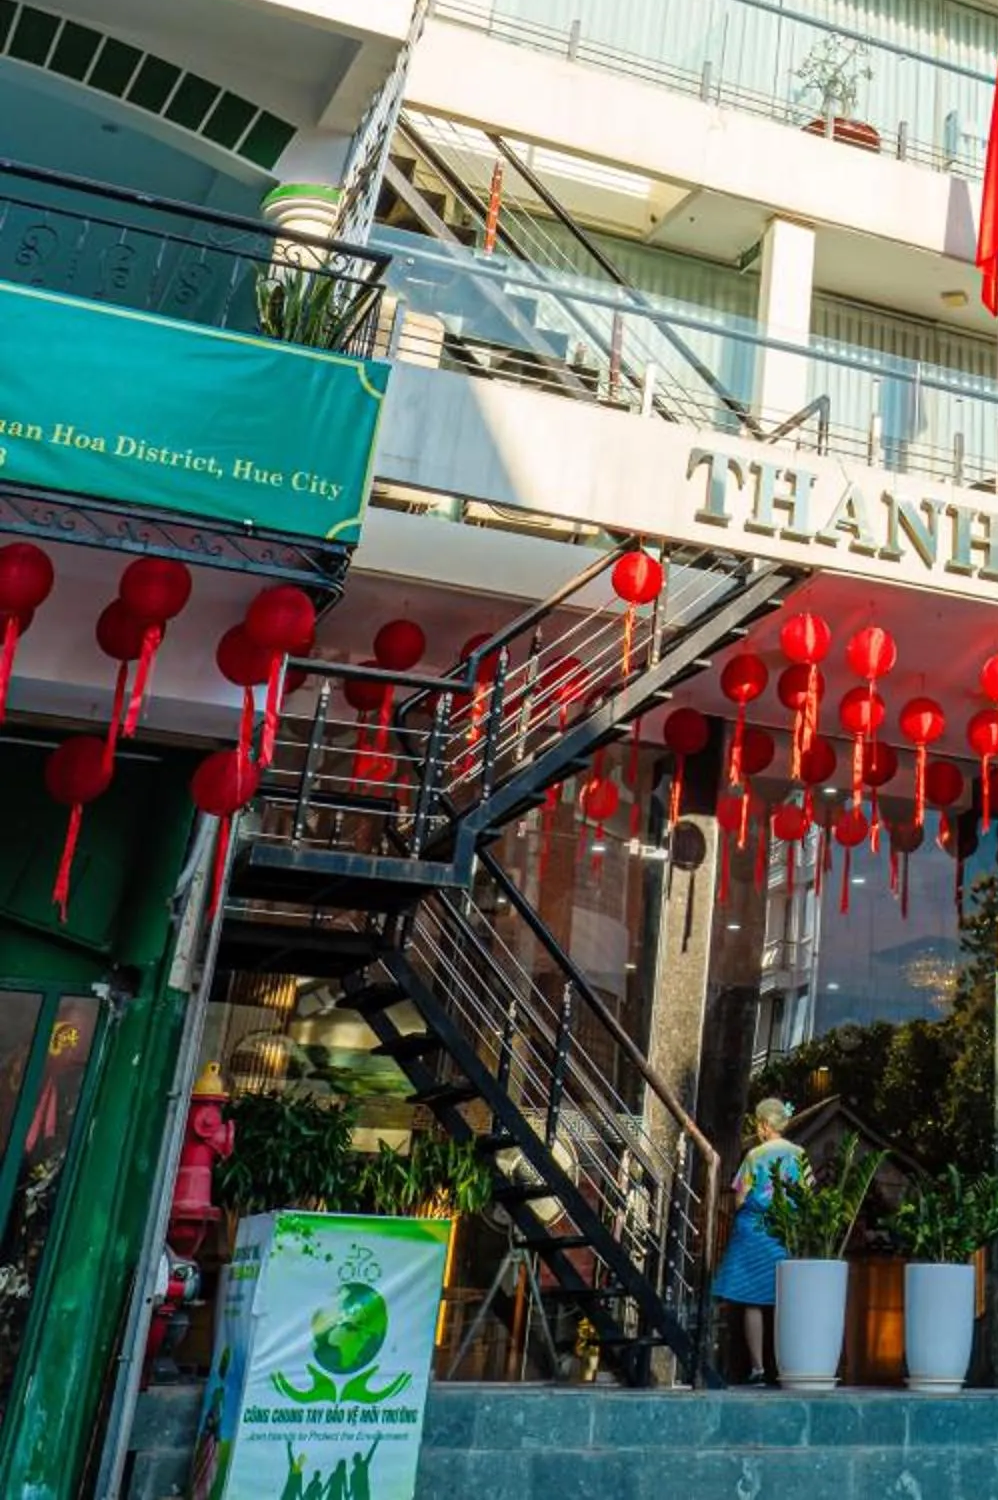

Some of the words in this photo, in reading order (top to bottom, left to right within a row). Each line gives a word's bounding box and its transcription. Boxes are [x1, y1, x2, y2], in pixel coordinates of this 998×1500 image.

[49, 423, 106, 453] Hoa
[114, 434, 224, 476] District,
[232, 459, 283, 488] Hue
[291, 470, 344, 500] City
